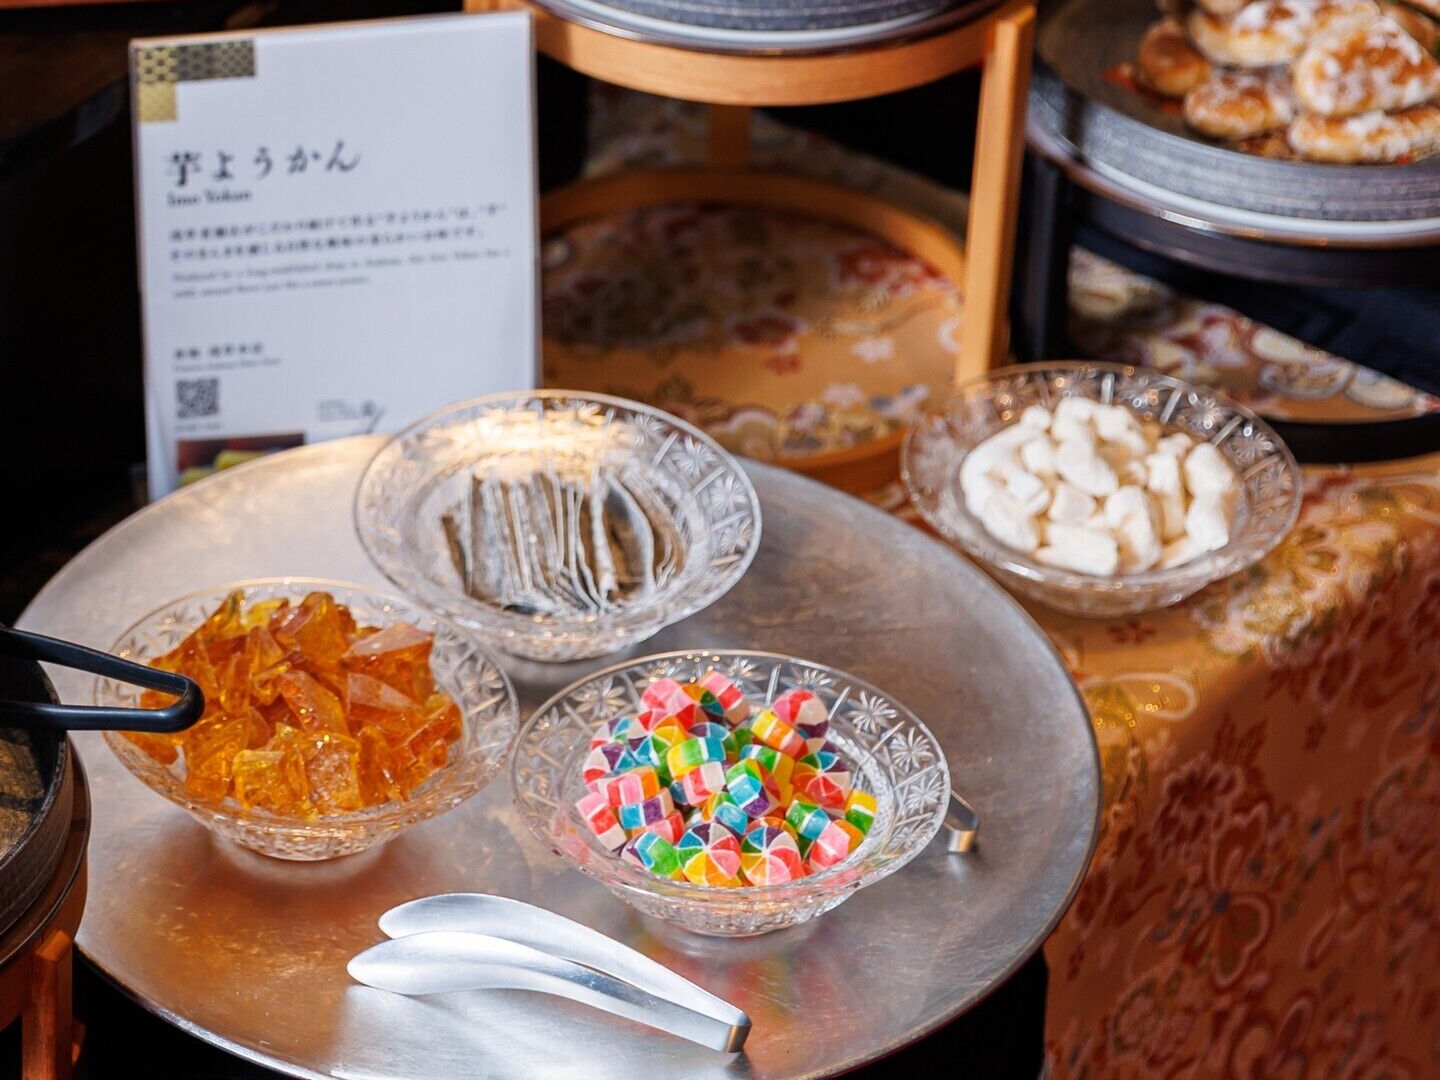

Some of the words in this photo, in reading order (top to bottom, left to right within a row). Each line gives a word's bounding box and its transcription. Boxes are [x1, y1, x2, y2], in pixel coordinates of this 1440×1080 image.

[166, 139, 361, 187] 芋ようかん
